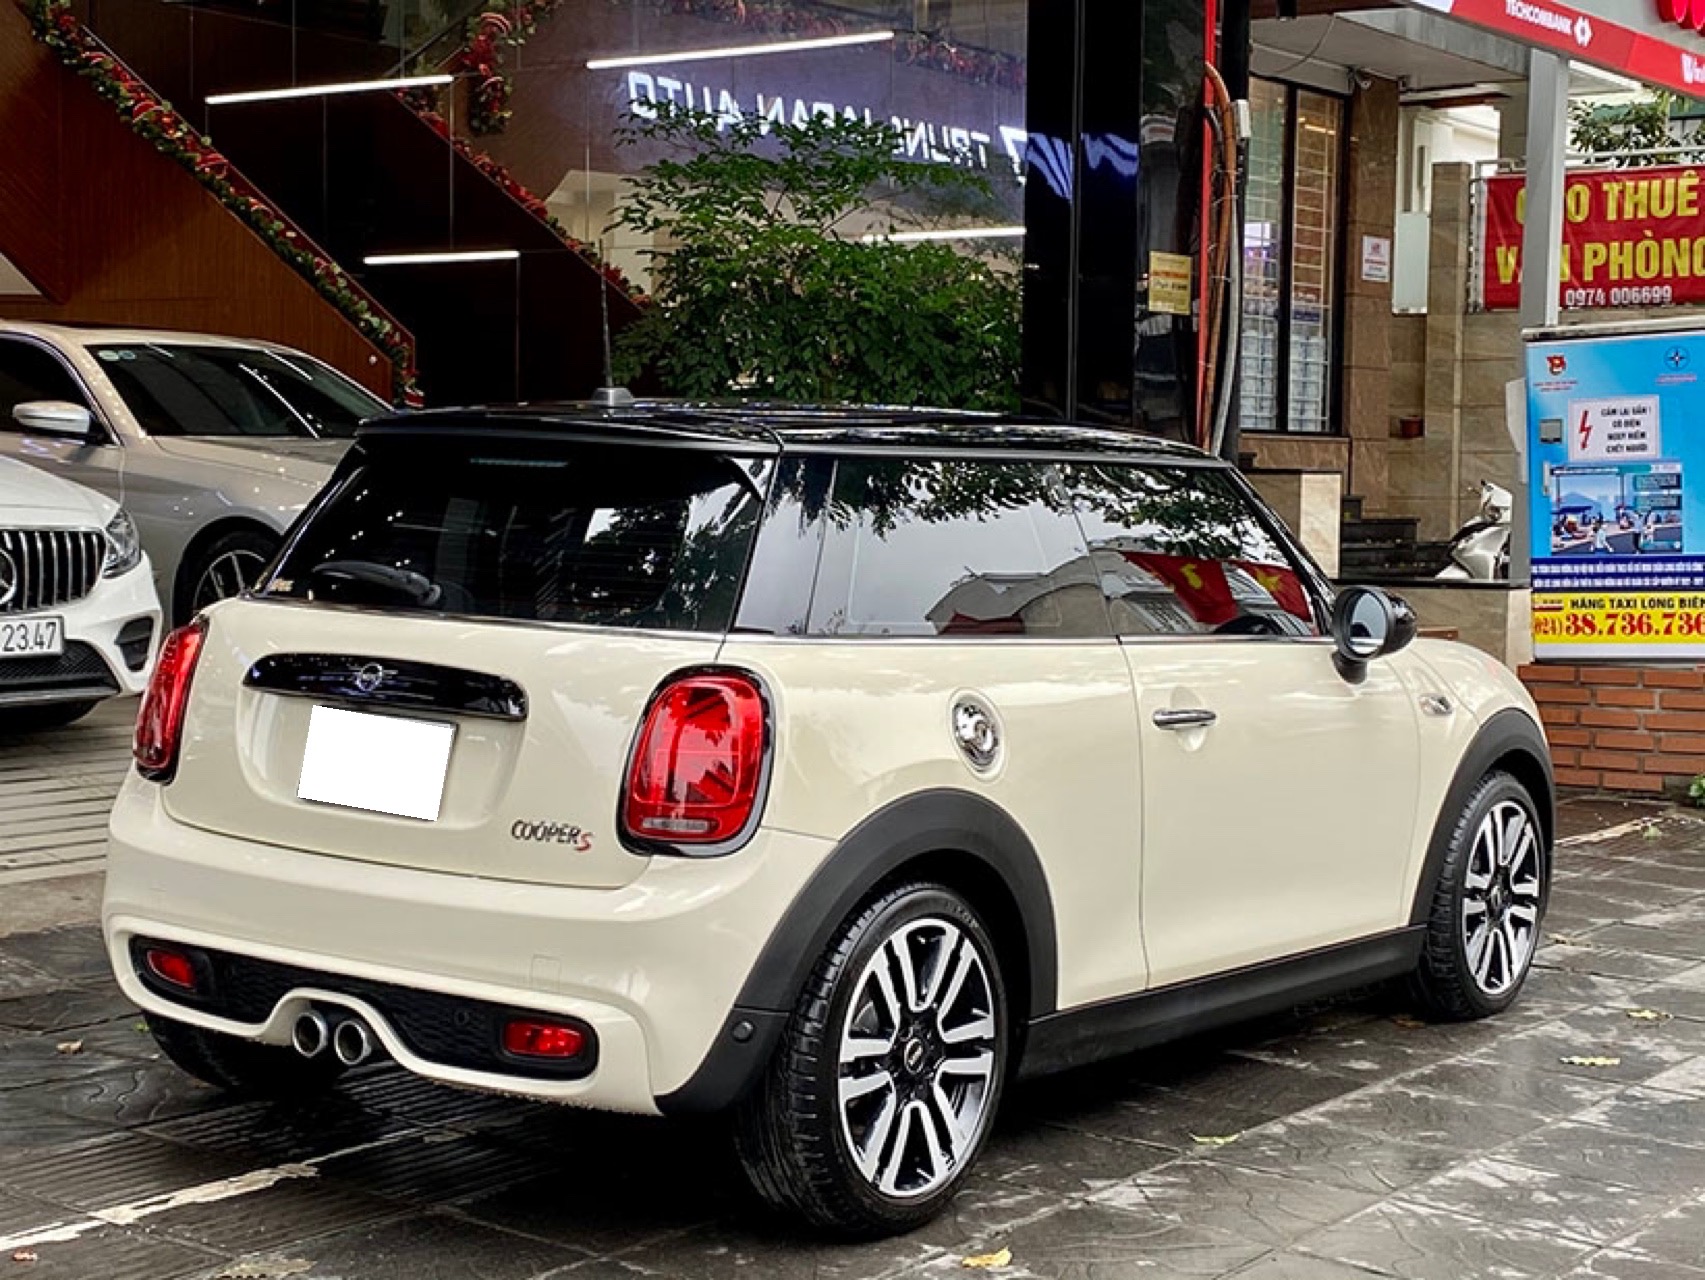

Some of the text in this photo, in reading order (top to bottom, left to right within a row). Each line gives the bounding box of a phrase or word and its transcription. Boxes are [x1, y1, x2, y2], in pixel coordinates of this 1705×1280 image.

[1602, 169, 1700, 221] THUÊ
[1565, 284, 1673, 306] 0974 006699
[1609, 598, 1637, 609] TAXI
[1640, 598, 1675, 609] LONG
[2, 621, 57, 652] 23.47
[511, 819, 581, 844] COOPER
